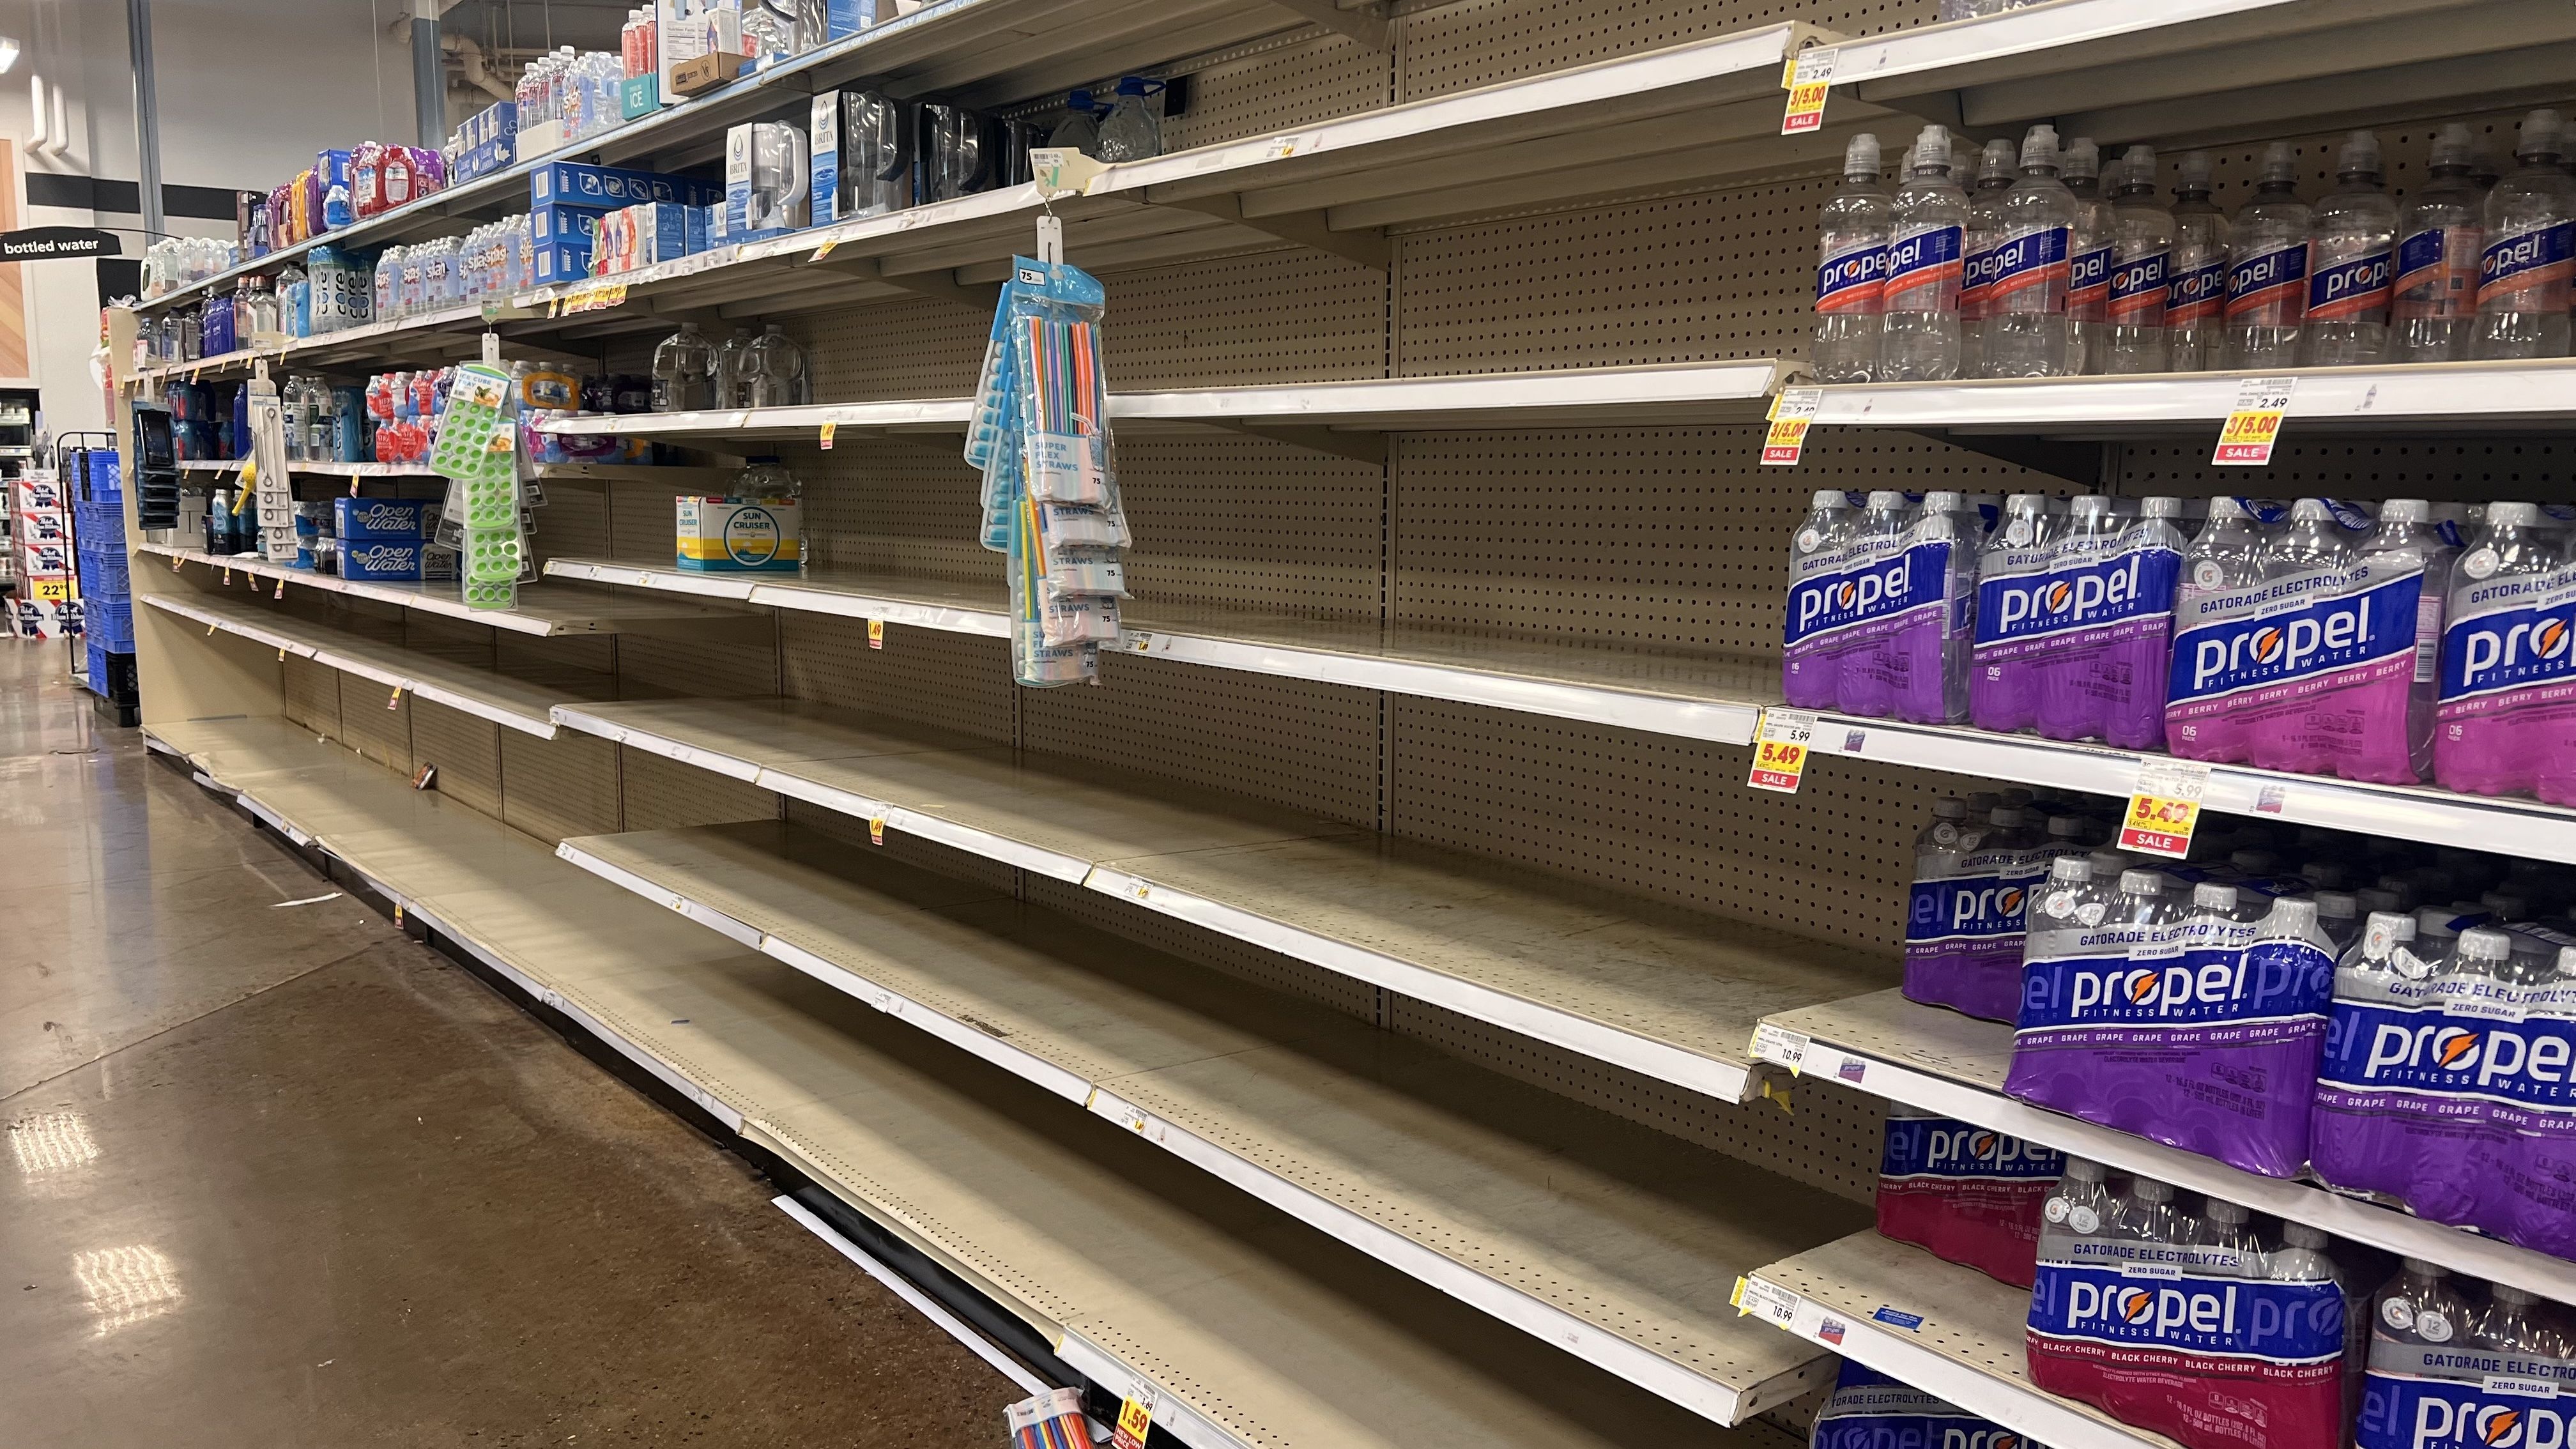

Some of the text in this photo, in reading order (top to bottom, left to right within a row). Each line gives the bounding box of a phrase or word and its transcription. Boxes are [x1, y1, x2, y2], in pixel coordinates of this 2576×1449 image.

[1813, 68, 1832, 79] 2.49
[630, 91, 643, 109] ICE
[1791, 86, 1825, 107] 3/5.00
[1791, 115, 1814, 126] SALE
[815, 132, 834, 145] BRITA
[730, 161, 747, 176] BRITA
[4, 240, 98, 254] bottled water
[1021, 272, 1032, 280] 75
[335, 273, 346, 314] core
[348, 277, 358, 319] core
[360, 277, 369, 319] core
[458, 378, 476, 388] TRAY
[459, 371, 491, 385] ICE CUBE
[2258, 397, 2288, 409] 2.49
[1770, 422, 1806, 440] 3/5.00
[2226, 416, 2278, 436] 3/5.00
[1035, 442, 1066, 450] SUPER
[1769, 449, 1793, 458] SALE
[2225, 447, 2260, 458] SALE
[1036, 451, 1060, 459] FLEX
[1036, 460, 1078, 471] STRAWS
[370, 503, 415, 518] Open
[1054, 507, 1094, 516] STRAWS
[366, 517, 416, 530] Water
[733, 521, 770, 530] CRUISER
[369, 545, 414, 558] Open
[365, 558, 415, 571] Water
[2053, 556, 2093, 569] ZERO SUGAR
[1799, 553, 1913, 633] propel
[1999, 555, 2142, 634] propel
[2200, 567, 2368, 614] GATORADE ELECTROLYTES
[2261, 599, 2306, 615] ZERO SUGAR
[2545, 594, 2564, 606] ZERO
[1048, 604, 1090, 613] STRAWS
[1807, 595, 1909, 629] FITNESS WATER
[2011, 602, 2135, 632] FITNESS WATER
[1820, 610, 1938, 646] GRAPE GRAPE GRAPE
[1993, 632, 2110, 657] GRAPE GRAPE GRAPE GRAPE
[2193, 595, 2376, 691] propel
[1033, 649, 1073, 657] STRAWS
[1987, 666, 2001, 676] 06
[2207, 645, 2366, 687] FITNESS WATER
[2476, 660, 2565, 684] FITNESS
[2188, 703, 2219, 715] BERRY
[2227, 696, 2253, 708] BERRY
[2259, 689, 2289, 701] BERRY
[2297, 680, 2329, 693] BERRY
[2337, 672, 2368, 684] BERRY
[2376, 661, 2407, 677] BERRY
[2455, 687, 2575, 715] BERRY BERRY BERRY
[1790, 730, 1810, 742] 5.99
[2182, 725, 2197, 737] 06
[2448, 725, 2463, 736] 06
[1762, 743, 1800, 765] 5.49
[1761, 773, 1788, 786] SALE
[2174, 783, 2202, 797] 5.99
[2135, 797, 2189, 824] 5.49
[2136, 833, 2173, 849] SALE
[1961, 855, 2014, 868] GATORADE
[1963, 919, 2021, 930] FITNESS
[2080, 926, 2257, 947] GATORADE ELECTROLYTES
[2136, 945, 2179, 957] ZERO SUGAR
[2071, 953, 2248, 1018] propel
[2083, 1003, 2239, 1018] FITNESS WATER
[2451, 1002, 2516, 1018] ZERO SUGAR
[2027, 1027, 2279, 1045] GRAPE GRAPE GRAPE GRAPE GRAPE GRAPE GRAPE
[1782, 1049, 1802, 1062] 10.99
[2383, 1069, 2470, 1085] FITNESS
[2347, 1096, 2528, 1126] GRAPE GRAPE GRAPE GRAPE
[1936, 1162, 2056, 1171] FITNESS WATER
[1931, 1183, 1955, 1192] CHERRY
[2073, 1243, 2241, 1267] GATORADE ELECTROLYTES
[2128, 1266, 2176, 1276] ZERO SUGAR
[1774, 1306, 1793, 1321] 10.99
[2067, 1281, 2242, 1338] propel
[2427, 1319, 2441, 1330] 12
[2081, 1322, 2234, 1346] FITNESS WATER
[2043, 1342, 2334, 1378] BLACK CHERRY BLACK CHERRY BLACK CHERRY BLACK CHERRY
[2423, 1353, 2500, 1372] GATORADE
[2518, 1384, 2550, 1393] SUGAR
[1867, 1393, 1940, 1405] ELECTROLYTES
[1123, 1400, 1147, 1434] 1.59
[1114, 1434, 1130, 1449] PRICE
[1116, 1428, 1143, 1449] NEW LOW
